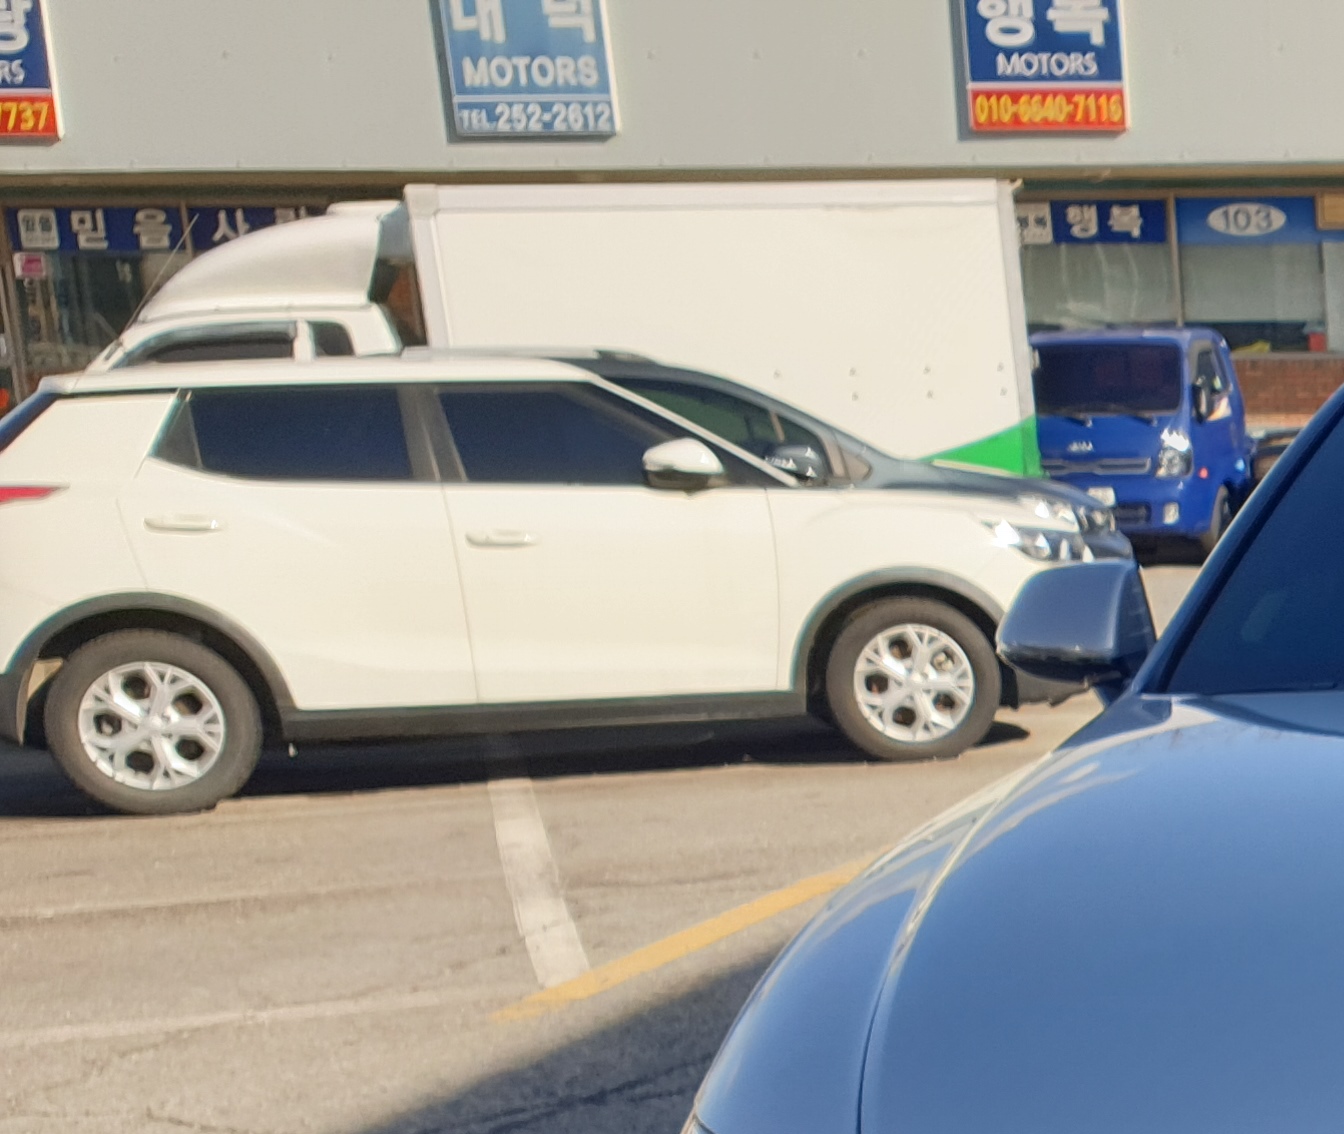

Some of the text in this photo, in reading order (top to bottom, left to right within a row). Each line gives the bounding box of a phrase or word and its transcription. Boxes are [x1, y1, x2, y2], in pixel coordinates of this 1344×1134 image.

[462, 55, 599, 87] MOTORS
[996, 52, 1099, 76] MOTORS
[1222, 207, 1273, 230] 103
